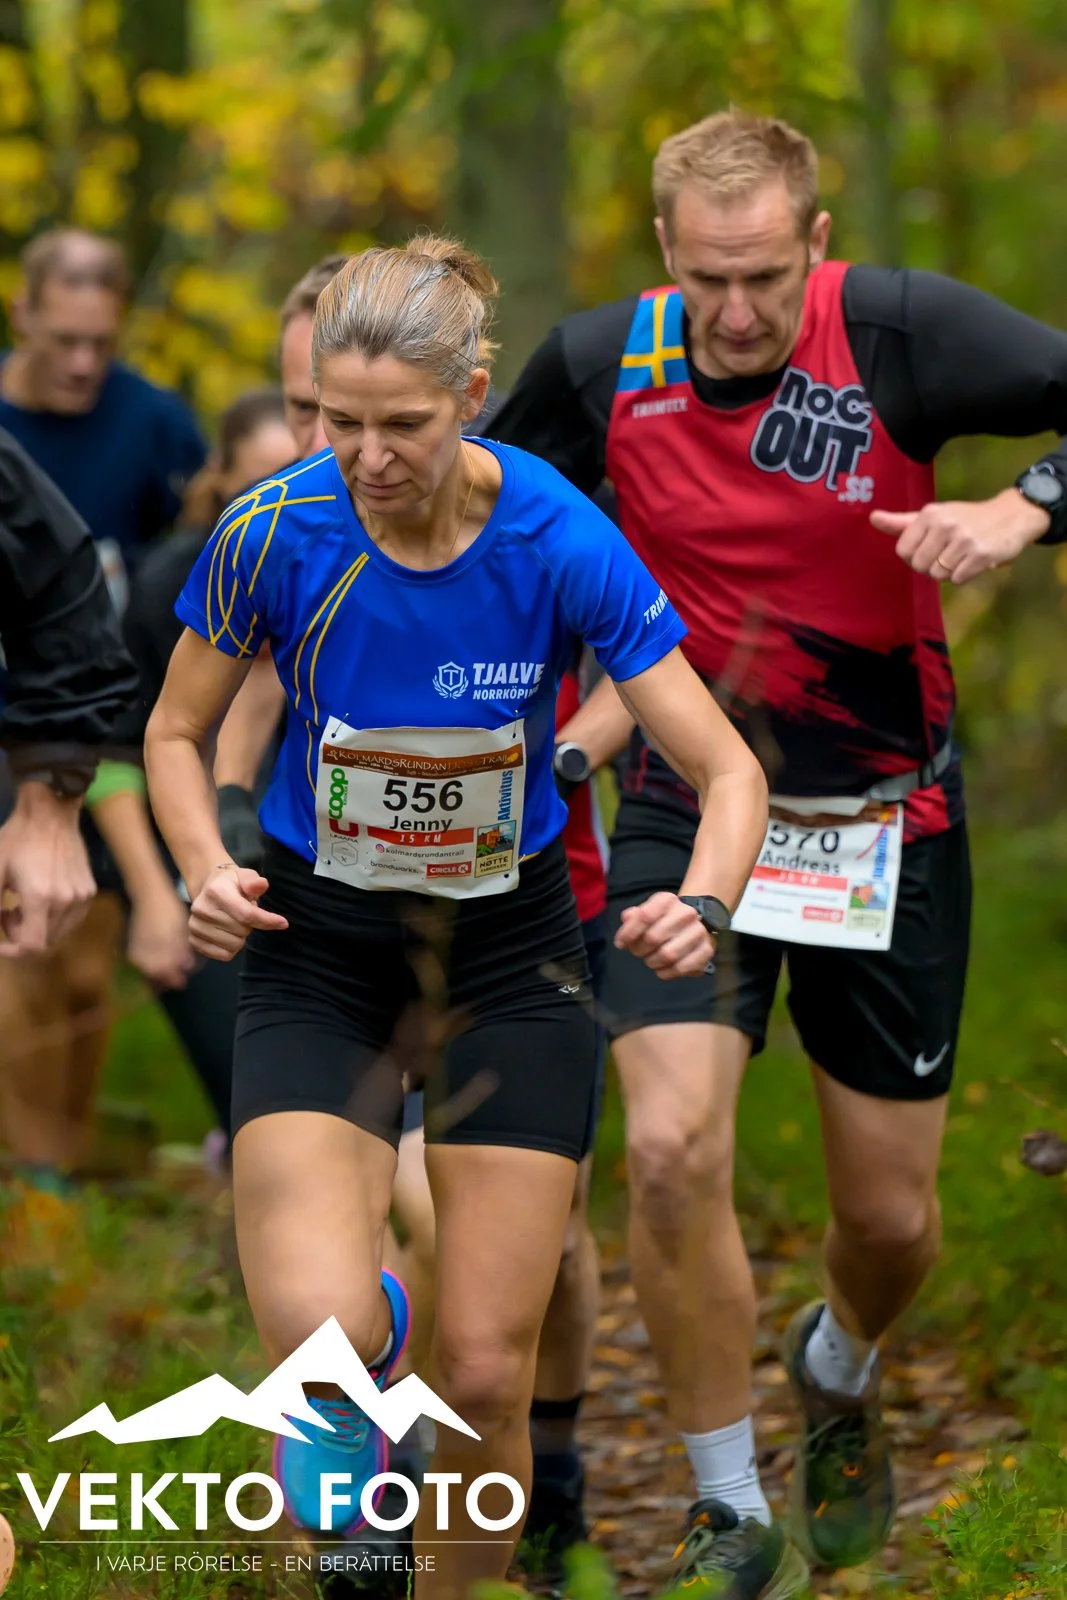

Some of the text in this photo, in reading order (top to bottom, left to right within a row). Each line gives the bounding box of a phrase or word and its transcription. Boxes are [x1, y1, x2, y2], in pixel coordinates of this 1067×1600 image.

[750, 406, 873, 491] OUT
[472, 662, 546, 685] TJALVE
[329, 768, 349, 819] coop
[382, 778, 464, 813] 556
[389, 815, 453, 833] Jenny
[768, 824, 840, 853] 570
[760, 851, 841, 875] Andreas
